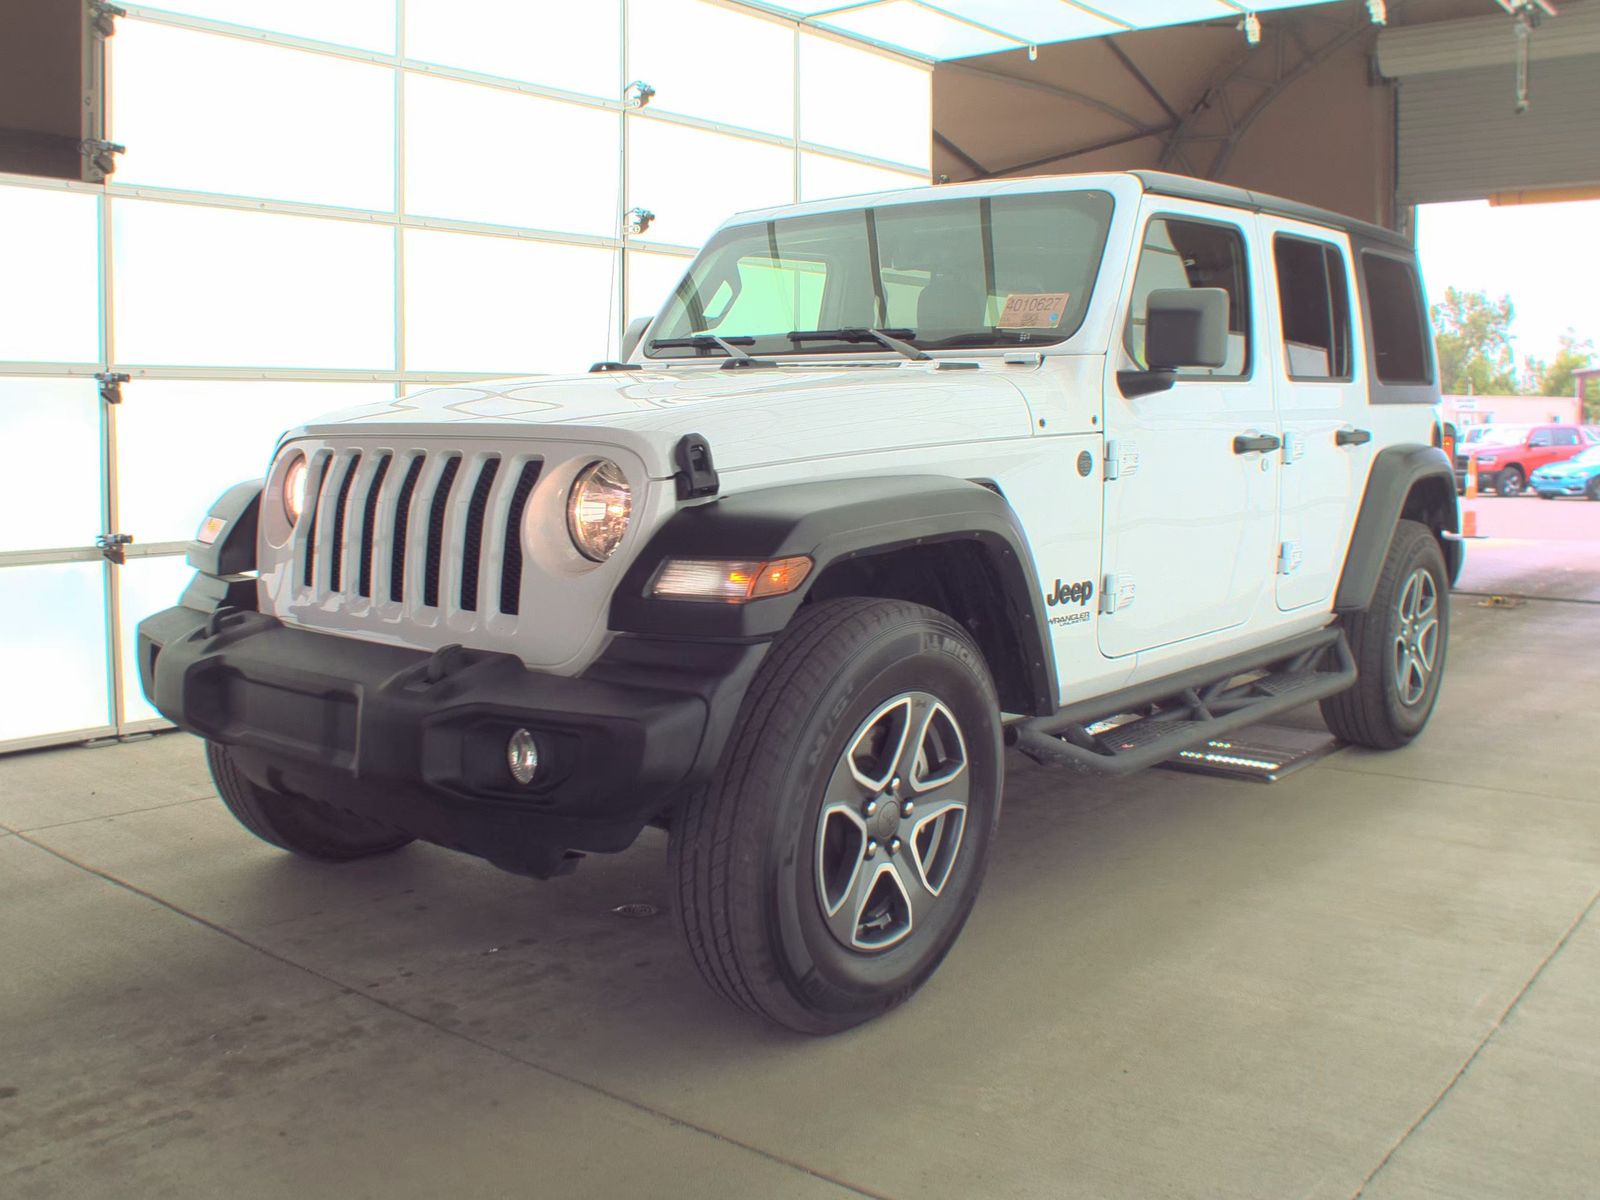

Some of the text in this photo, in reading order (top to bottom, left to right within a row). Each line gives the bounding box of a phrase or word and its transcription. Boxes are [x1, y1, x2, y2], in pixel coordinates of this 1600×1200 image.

[1005, 297, 1063, 312] 4010627
[1046, 578, 1093, 607] Jeep
[1048, 611, 1090, 624] WRANGLER
